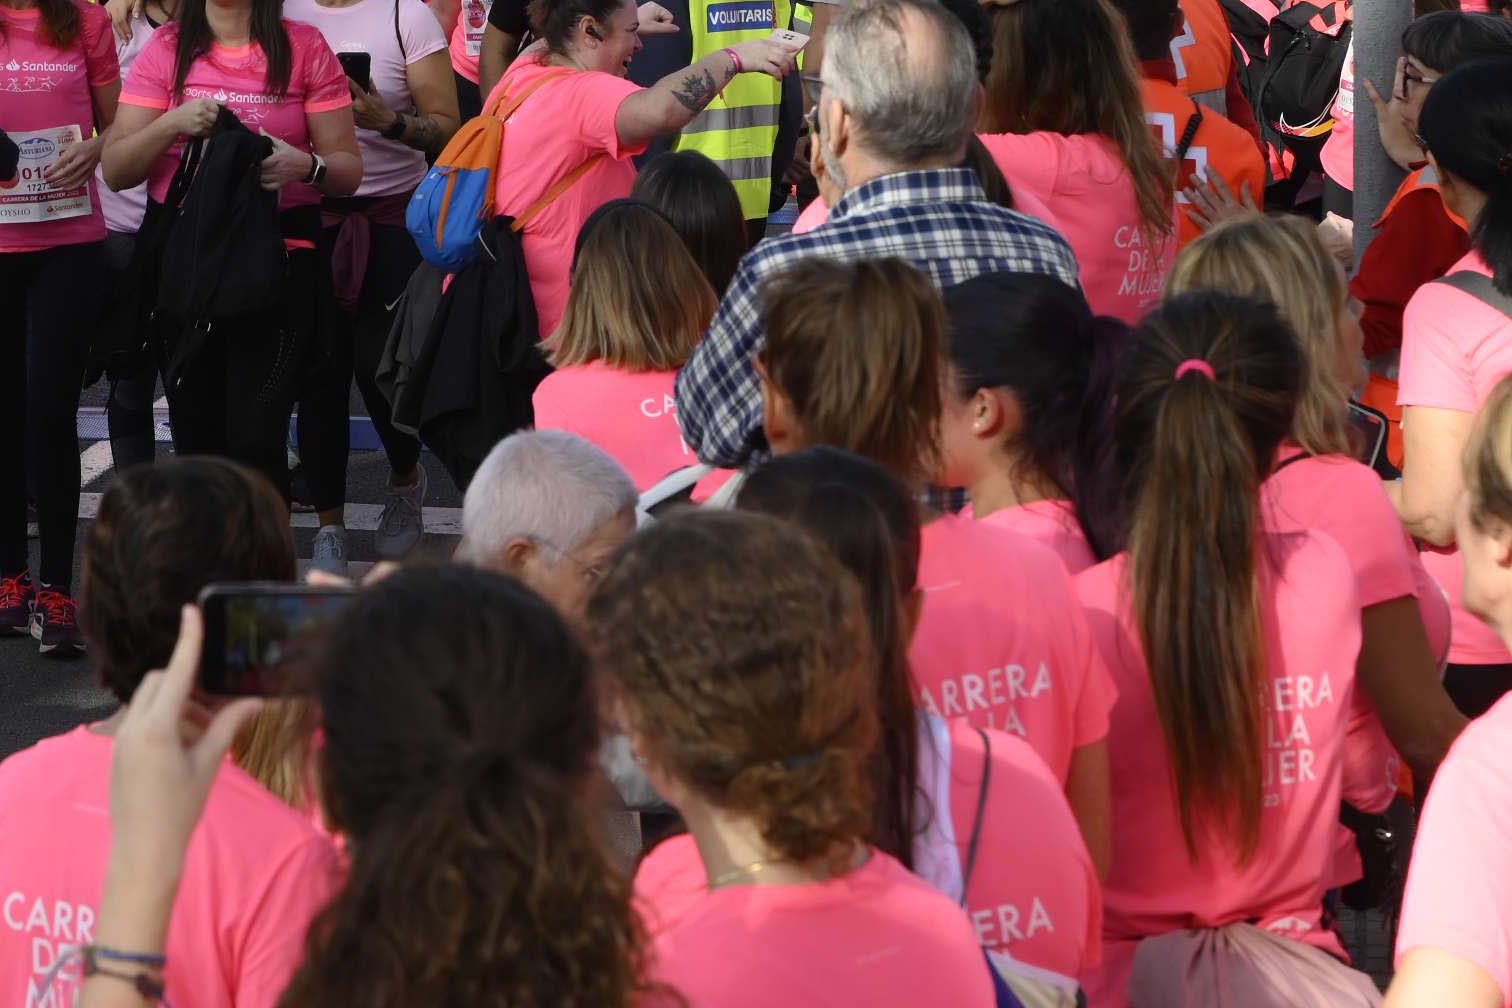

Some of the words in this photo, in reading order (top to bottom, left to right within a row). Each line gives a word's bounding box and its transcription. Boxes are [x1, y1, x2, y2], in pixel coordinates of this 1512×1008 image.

[21, 60, 78, 72] Santander
[2, 195, 29, 203] CARRERA
[0, 207, 31, 217] OYSHO
[53, 203, 84, 214] Santander
